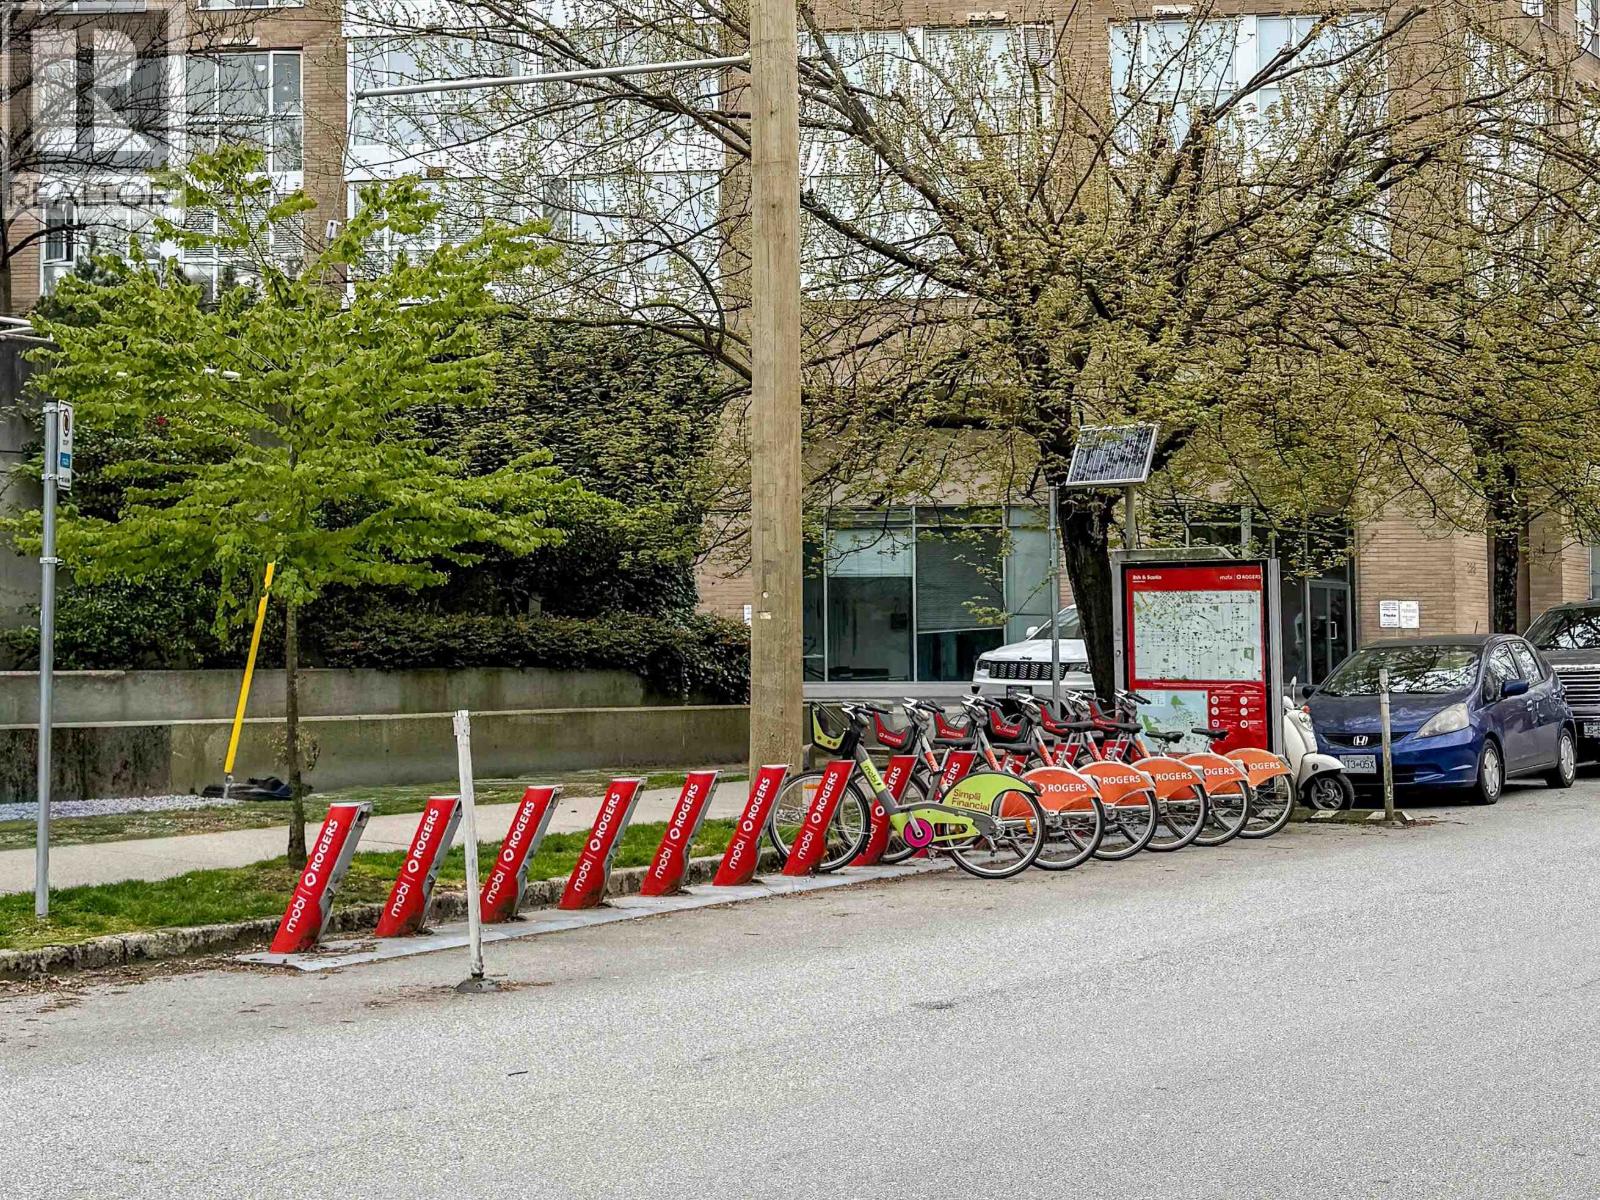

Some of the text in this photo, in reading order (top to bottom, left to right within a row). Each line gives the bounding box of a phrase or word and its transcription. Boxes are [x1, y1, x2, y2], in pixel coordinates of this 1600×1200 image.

[748, 776, 771, 821] ROGERS
[815, 771, 839, 813] ROGERS
[1047, 783, 1088, 793] ROGERS
[1103, 775, 1141, 785] ROGERS
[1155, 771, 1193, 781] ROGERS
[508, 800, 536, 849] ROGERS
[597, 792, 621, 839] ROGERS
[674, 783, 699, 829] ROGERS
[951, 797, 990, 811] Financial
[310, 819, 339, 873] ROGERS
[412, 808, 439, 859] ROGERS
